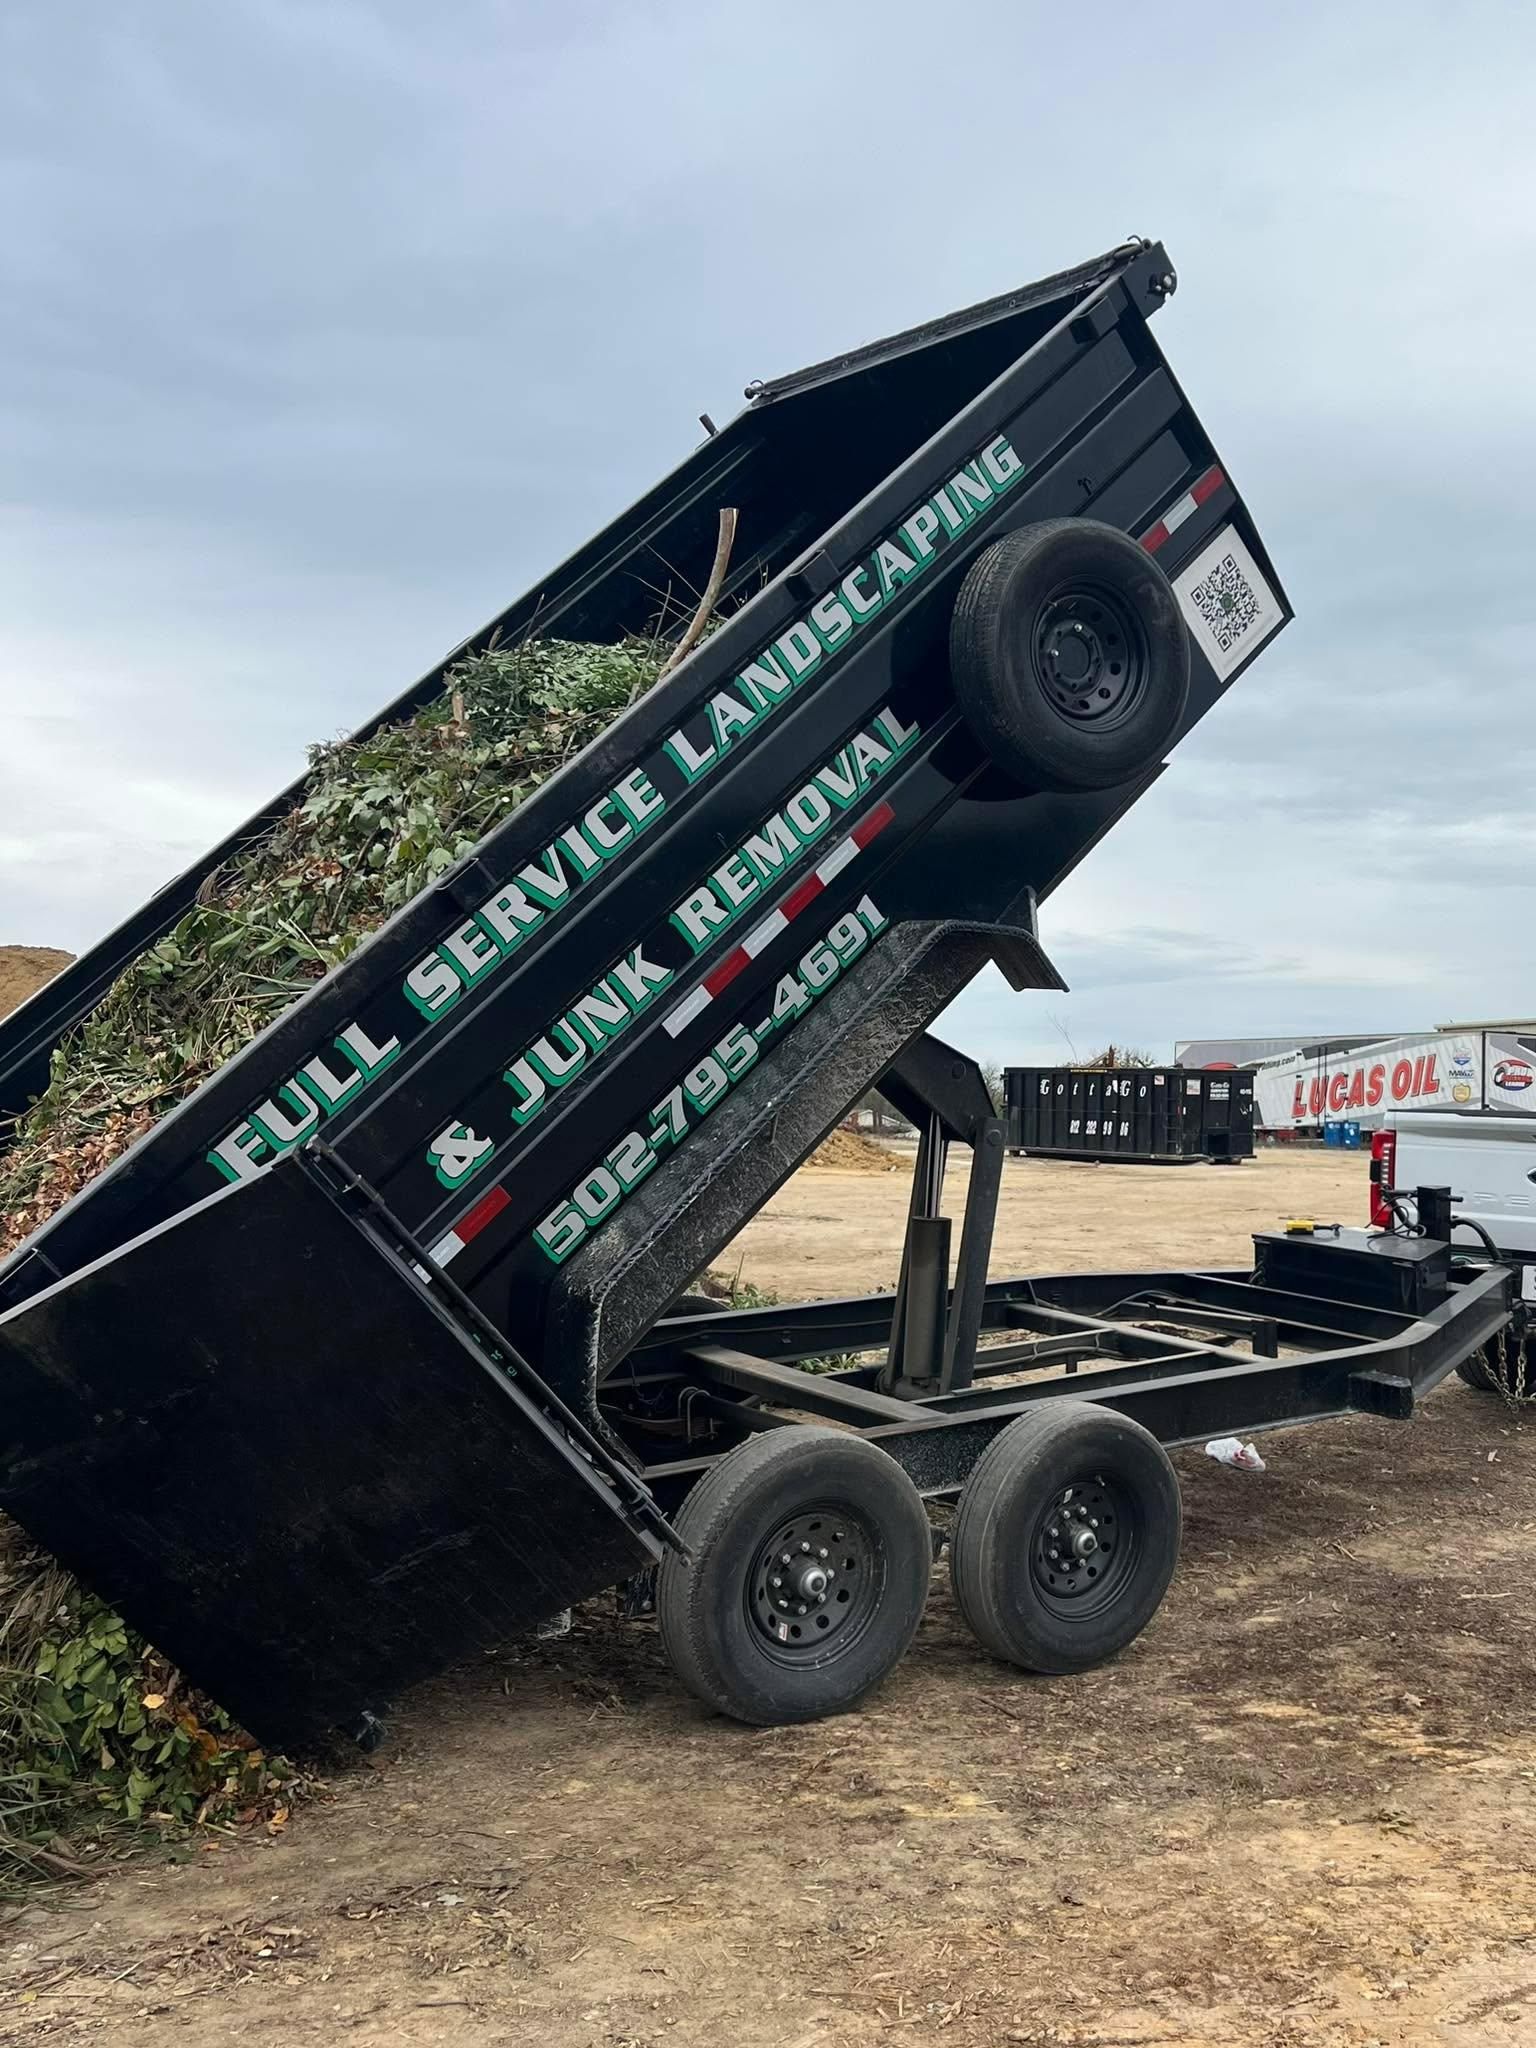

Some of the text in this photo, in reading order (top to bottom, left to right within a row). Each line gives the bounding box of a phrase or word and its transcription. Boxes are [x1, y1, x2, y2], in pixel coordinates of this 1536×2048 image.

[206, 434, 1025, 1184] FULL SERVICE LANDSCAPING
[427, 705, 921, 1190] & JUNK REMOVAL
[532, 894, 890, 1264] 502-795-4691
[1291, 1054, 1440, 1119] LUCAS OIL
